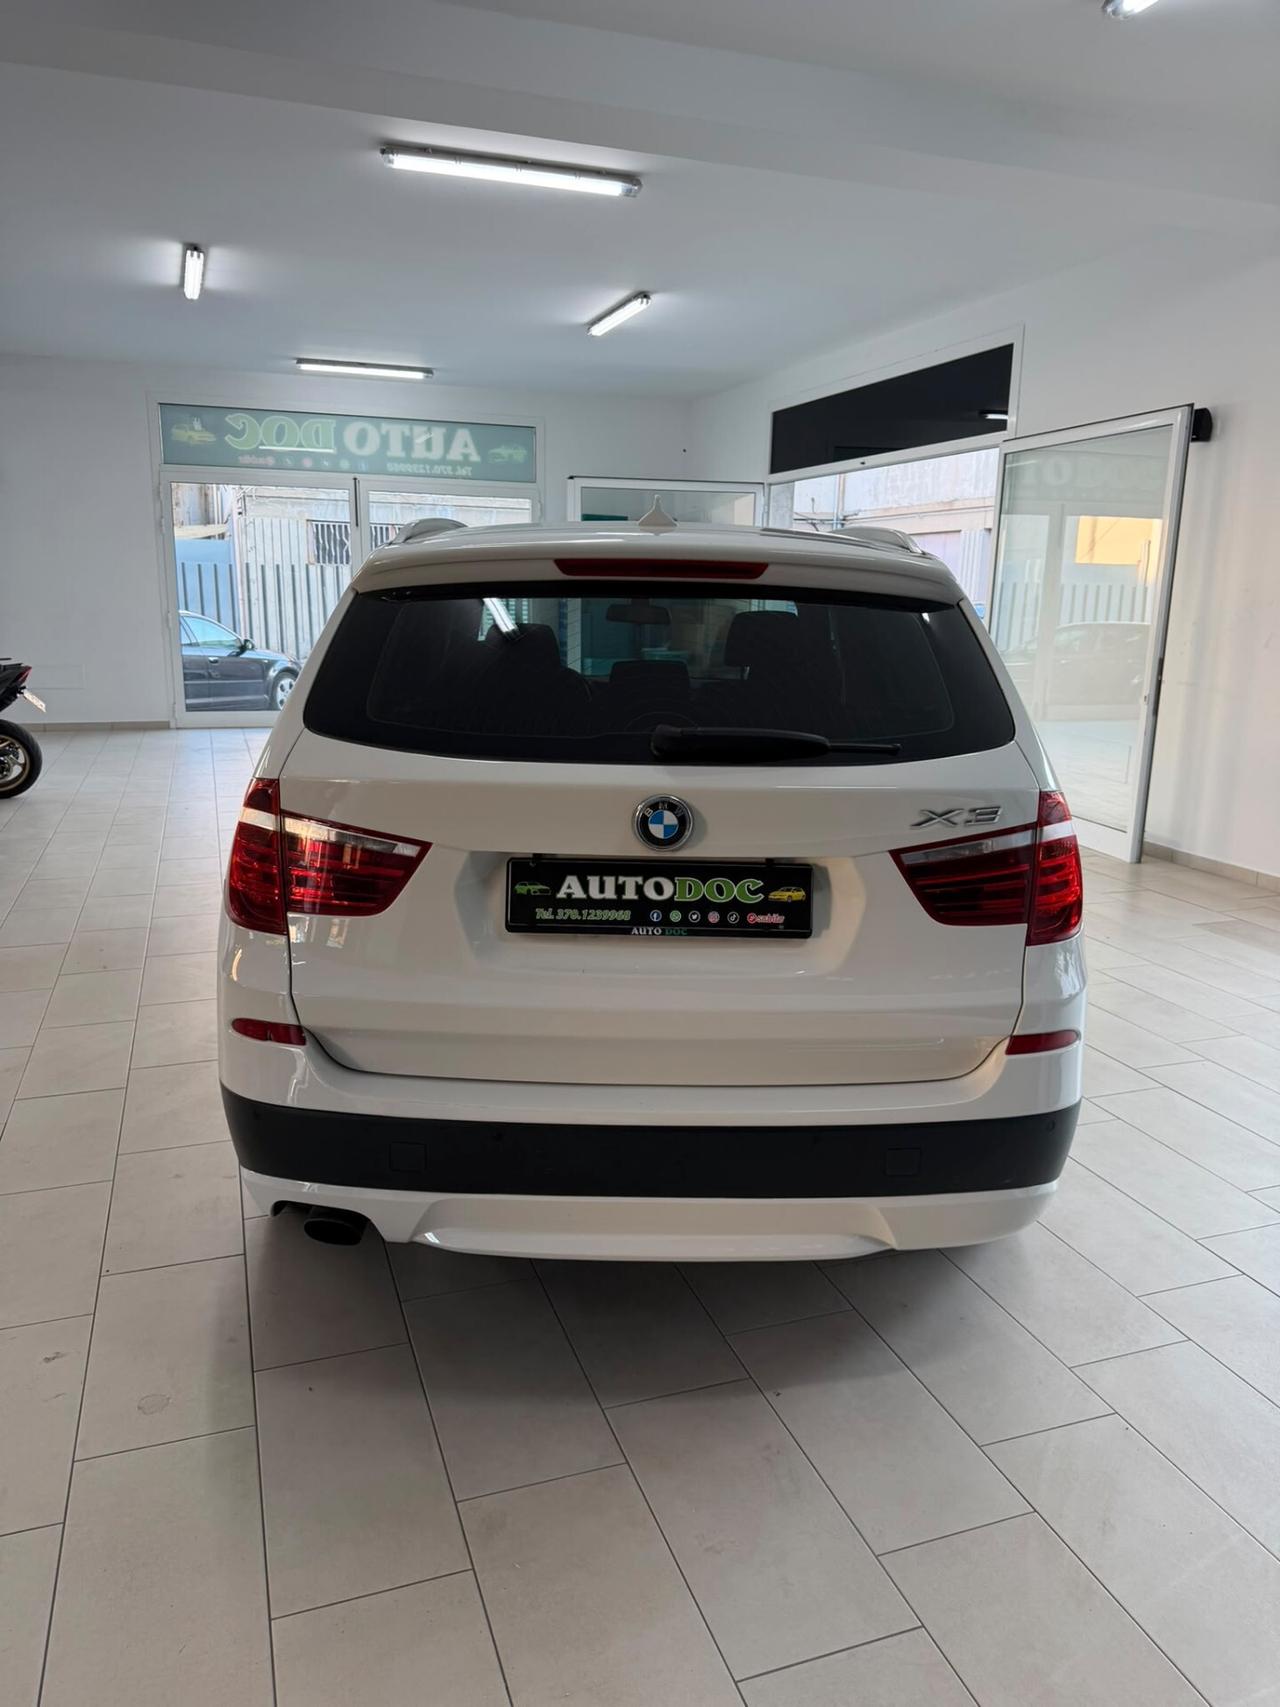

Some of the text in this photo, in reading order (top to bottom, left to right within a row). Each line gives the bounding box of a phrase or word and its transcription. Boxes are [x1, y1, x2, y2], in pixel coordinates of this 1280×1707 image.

[644, 800, 684, 818] BMW
[910, 806, 1003, 829] X3
[631, 927, 688, 936] AUTO DOC
